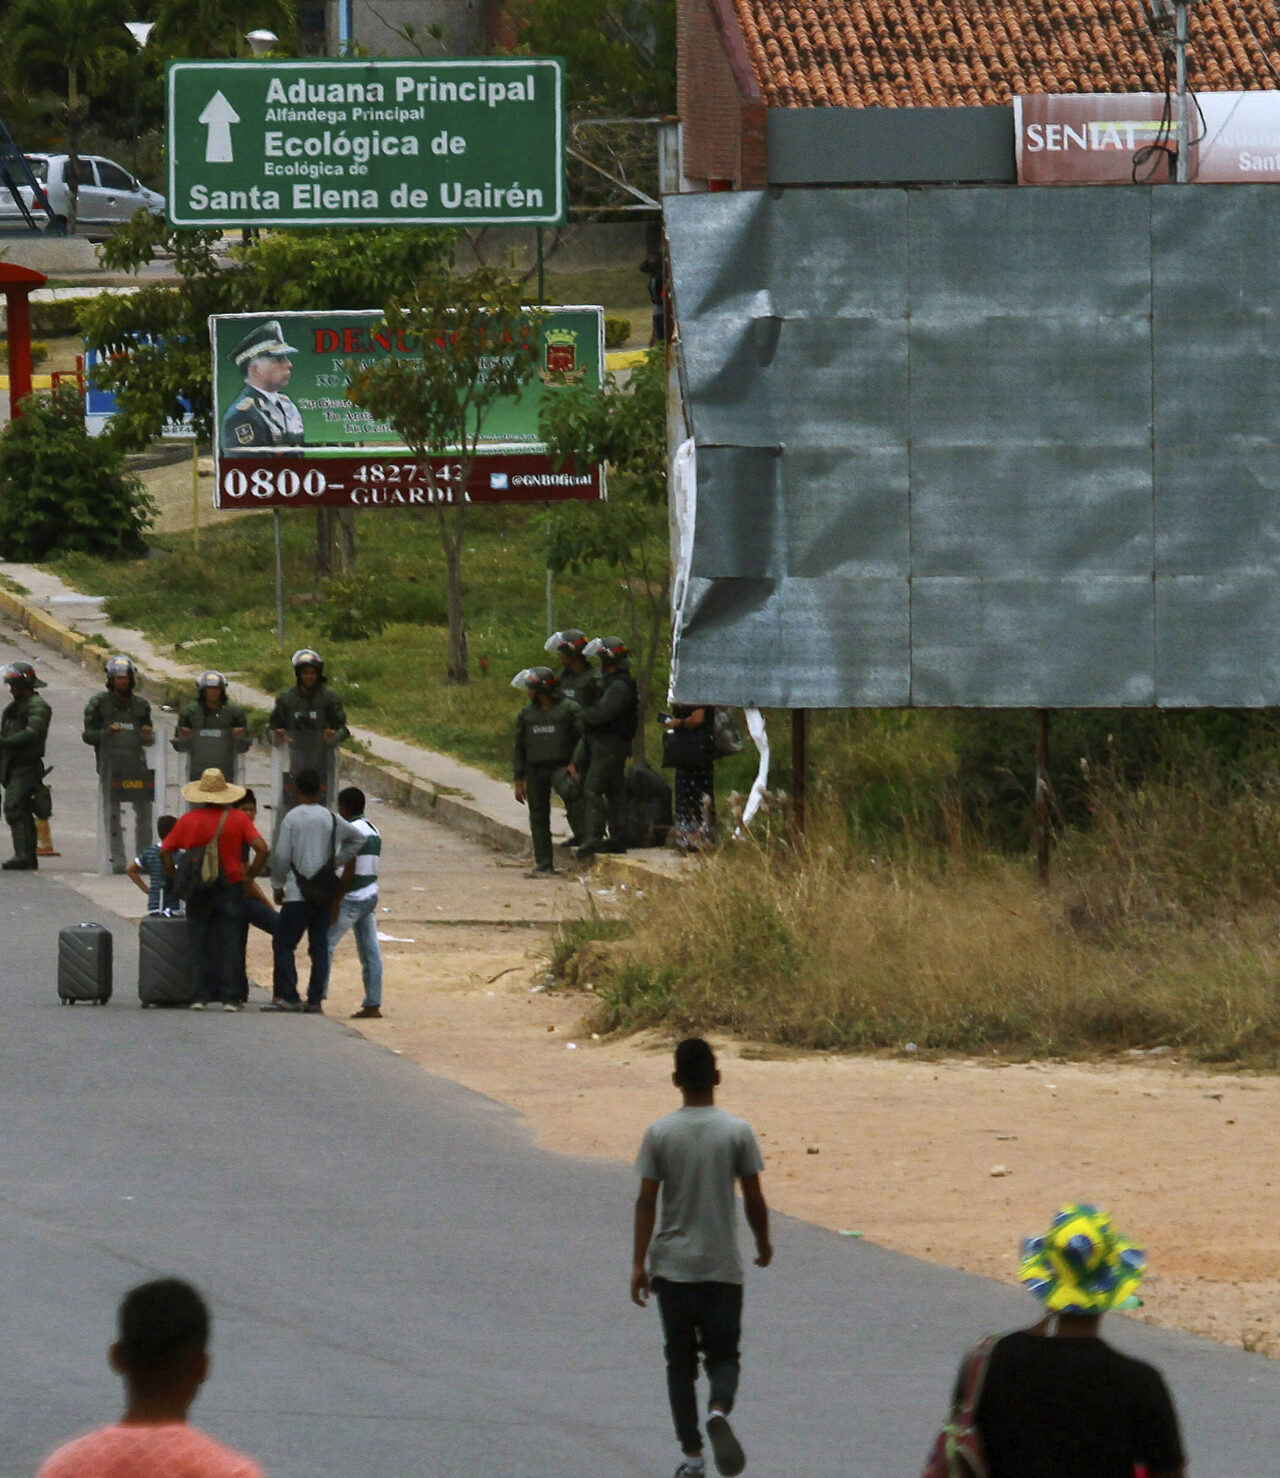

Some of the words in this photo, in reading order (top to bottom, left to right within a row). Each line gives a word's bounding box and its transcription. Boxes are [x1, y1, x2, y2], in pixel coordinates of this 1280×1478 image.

[266, 78, 384, 104] Aduana
[395, 75, 535, 108] Principal
[352, 106, 425, 123] Principal
[264, 130, 419, 162] Ecológica
[431, 130, 467, 155] de
[1026, 122, 1141, 151] SENIAT
[264, 161, 344, 178] Ecológica
[348, 162, 369, 176] de
[189, 184, 280, 210] Santa
[292, 183, 379, 209] Elena
[390, 183, 428, 208] de
[440, 182, 543, 208] Uairén
[224, 468, 345, 498] 0800-
